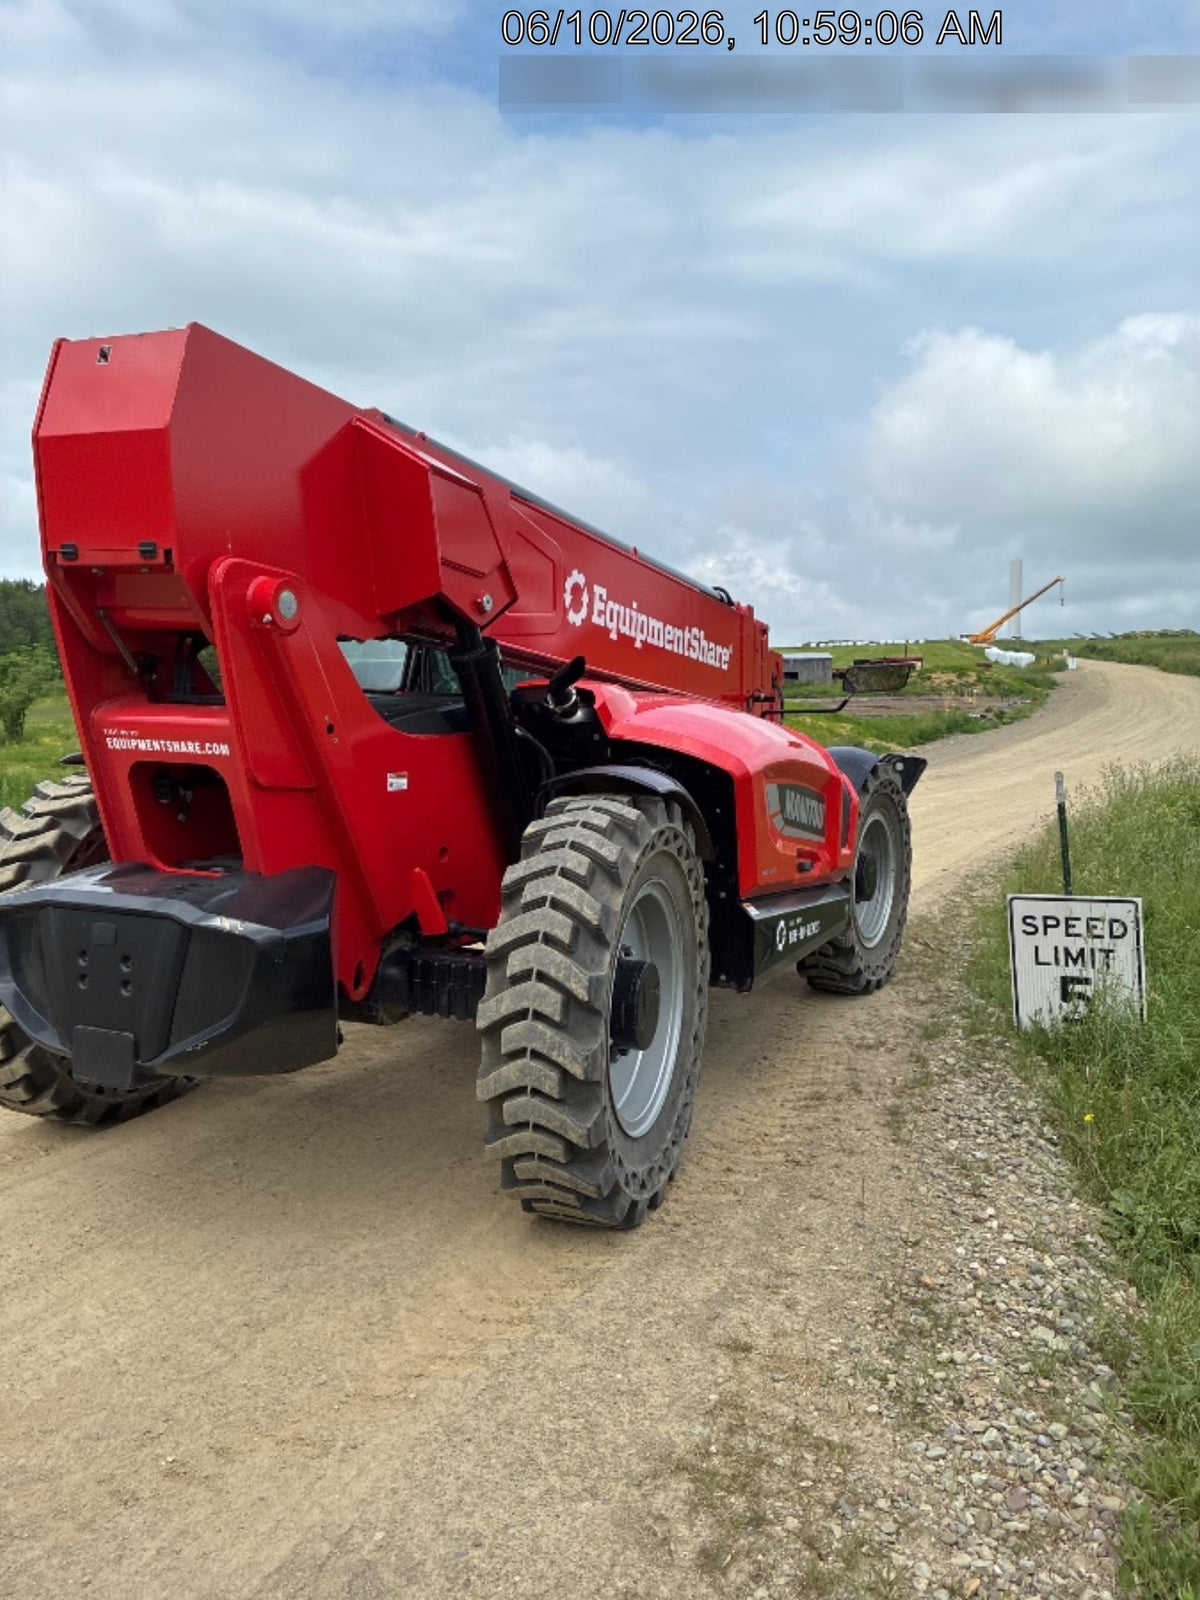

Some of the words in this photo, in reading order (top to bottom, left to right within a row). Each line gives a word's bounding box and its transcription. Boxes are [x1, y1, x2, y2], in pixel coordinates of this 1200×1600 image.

[105, 737, 230, 756] EQUIPMENTSHARE.COM
[1021, 915, 1128, 939] SPEED
[1034, 945, 1115, 970] LIMIT
